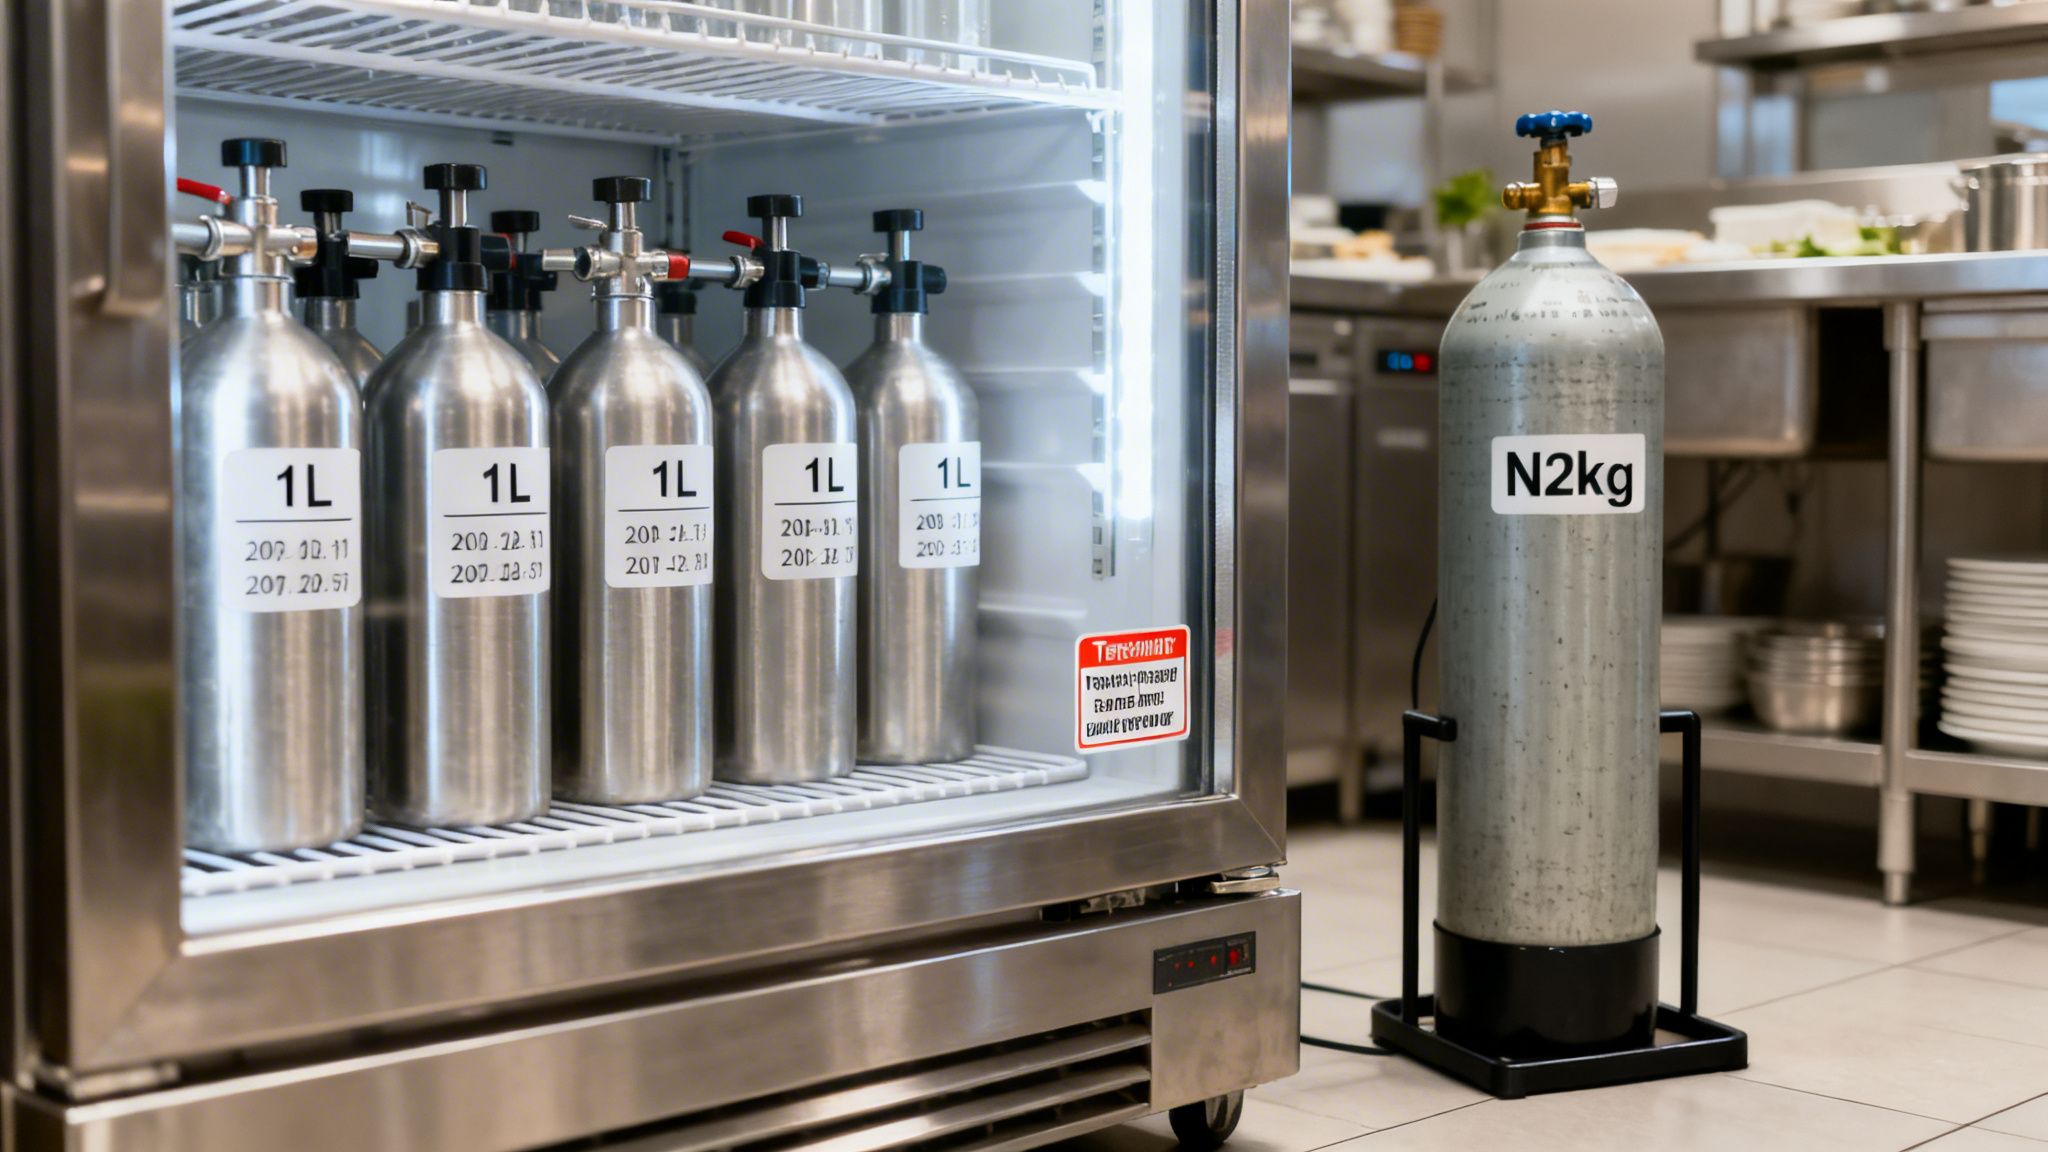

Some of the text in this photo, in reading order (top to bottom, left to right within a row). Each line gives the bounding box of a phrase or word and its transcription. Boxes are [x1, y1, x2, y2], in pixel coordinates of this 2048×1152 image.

[276, 464, 333, 508] 1L
[482, 463, 531, 504] 1L
[652, 459, 698, 498] 1L
[804, 457, 845, 493] 1L
[937, 457, 973, 489] 1L
[1506, 450, 1633, 508] N2kg
